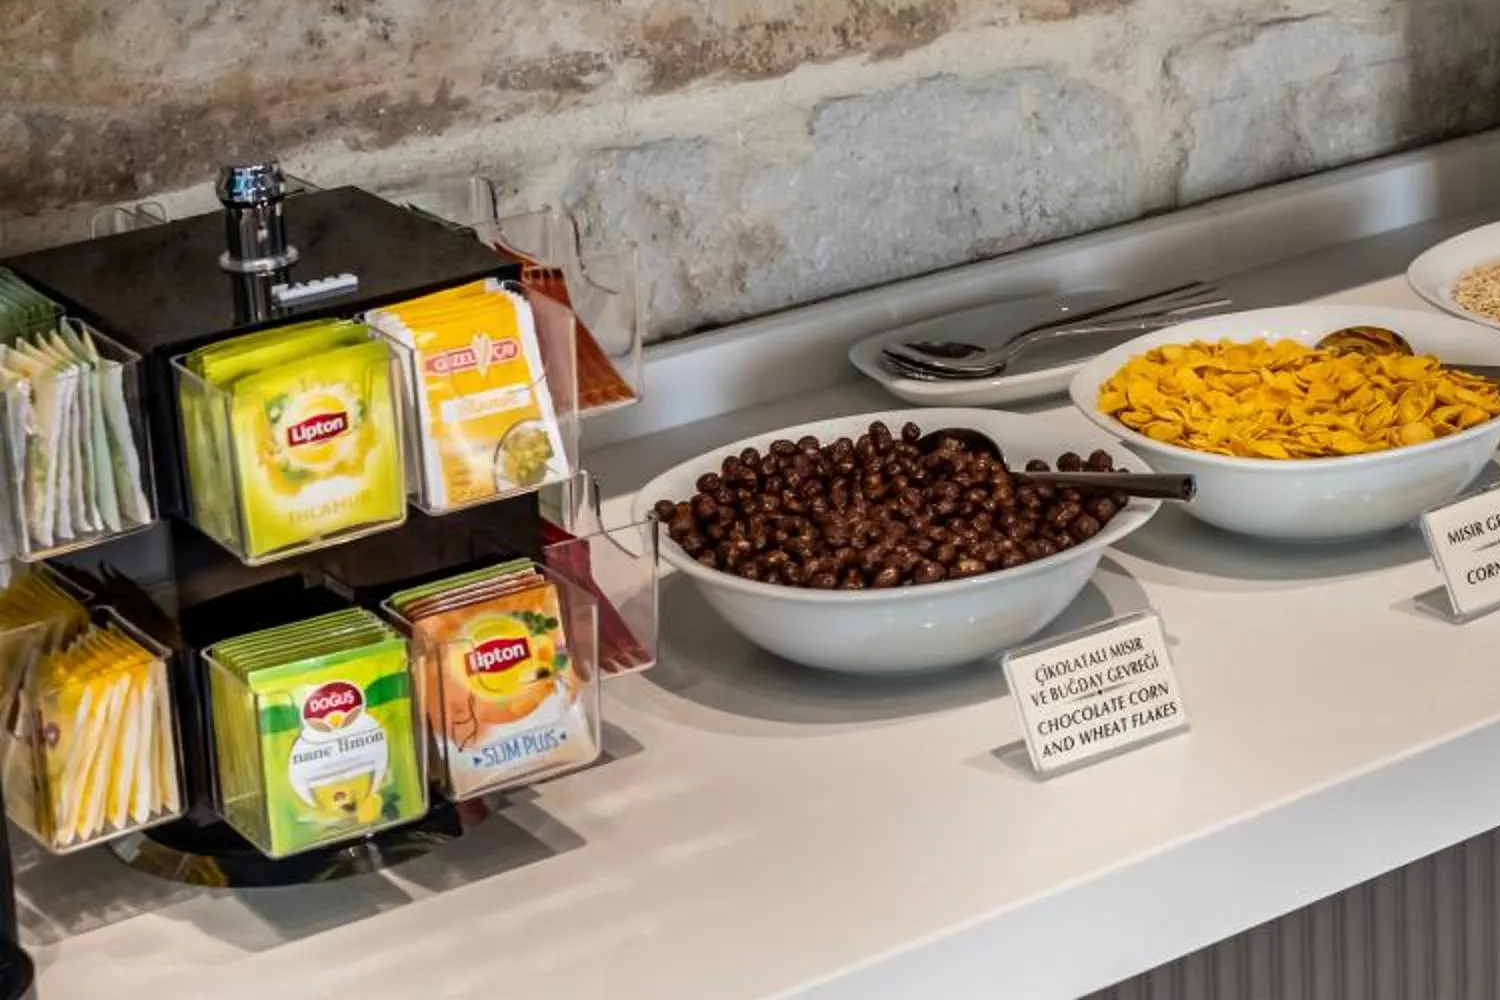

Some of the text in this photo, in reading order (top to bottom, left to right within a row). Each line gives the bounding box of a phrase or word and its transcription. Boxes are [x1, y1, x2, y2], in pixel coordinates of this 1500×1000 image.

[291, 417, 344, 442] Lipton
[1447, 520, 1485, 546] MISIR
[1109, 636, 1146, 659] MISIR
[1030, 690, 1048, 708] VE
[1048, 671, 1105, 704] BUĞDAY
[1037, 682, 1170, 737] CHOCOLATE CORN
[337, 730, 385, 753] limon
[1041, 701, 1178, 759] AND WHEAT FLAKES
[482, 728, 559, 767] SLIM PLUS
